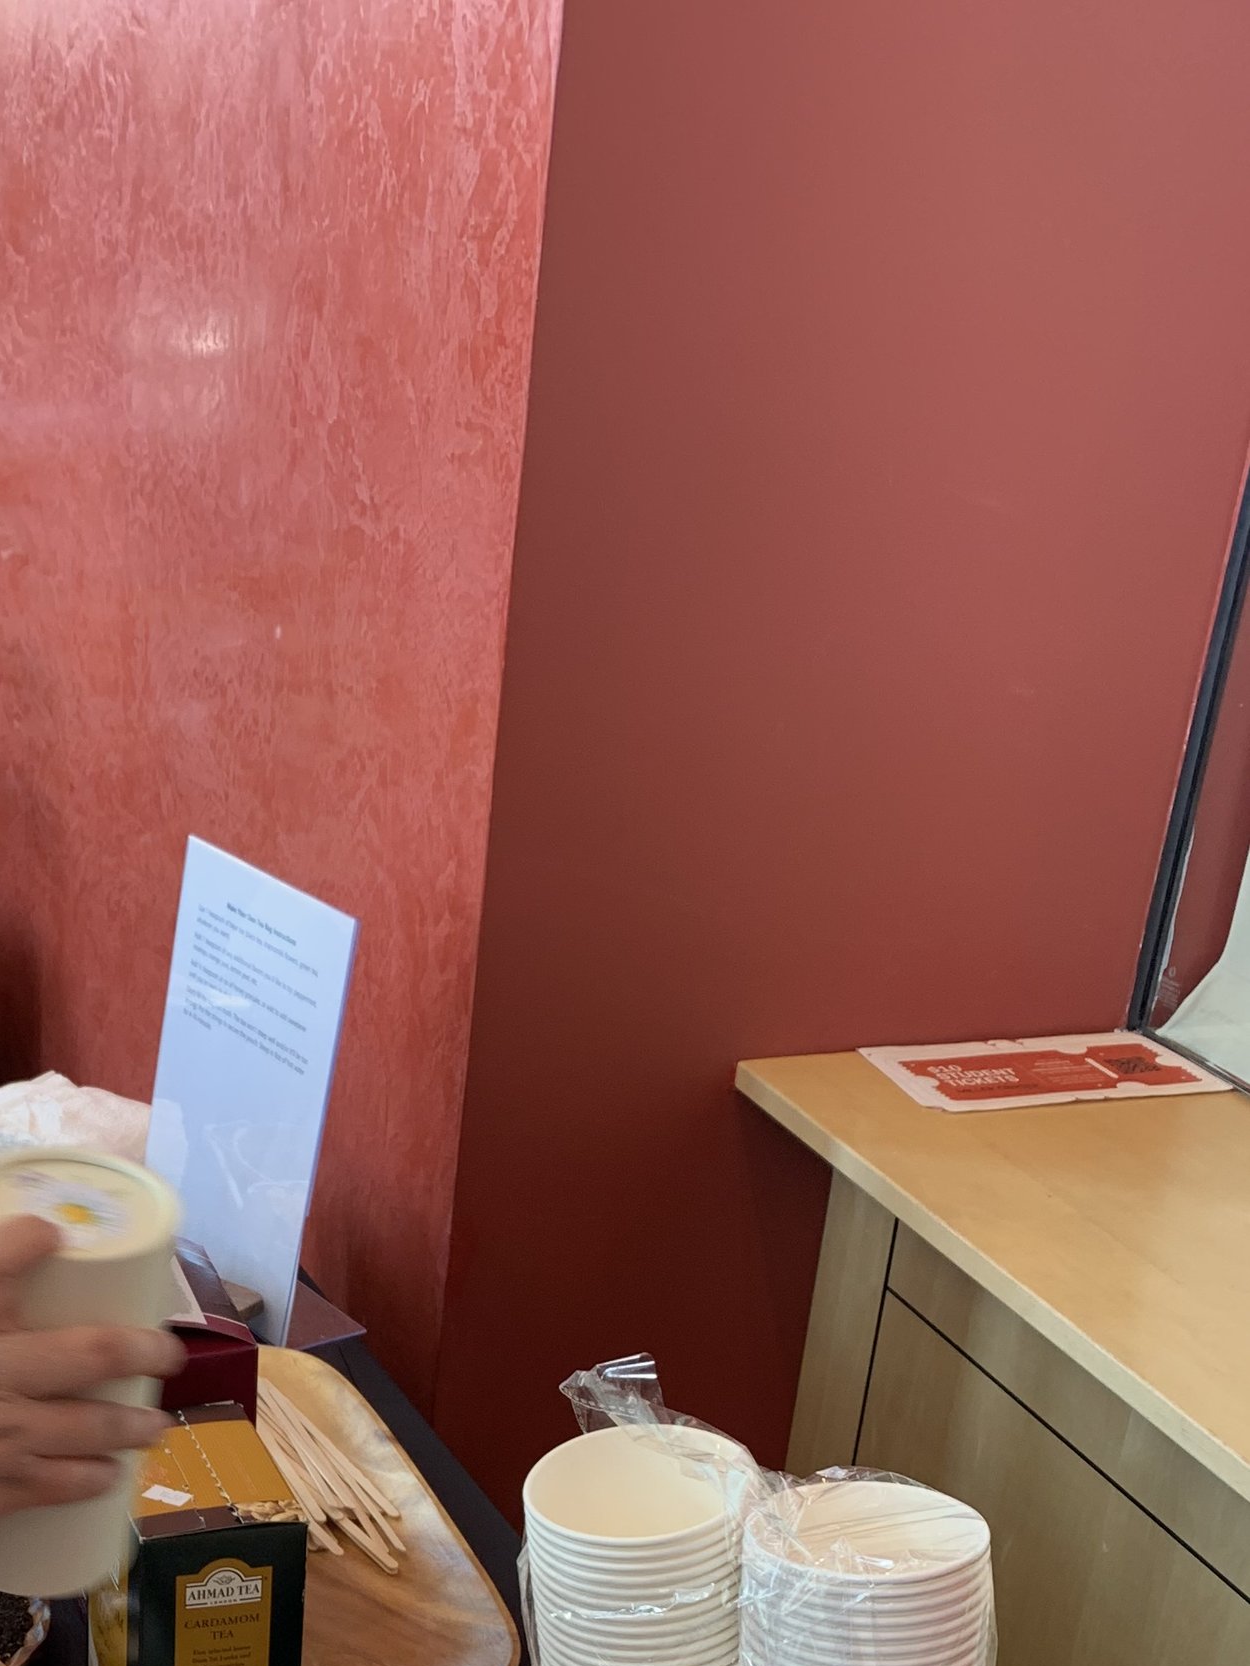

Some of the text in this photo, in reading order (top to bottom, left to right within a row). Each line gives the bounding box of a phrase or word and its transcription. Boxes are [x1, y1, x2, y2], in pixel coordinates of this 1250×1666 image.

[936, 1067, 1016, 1081] STUDENT
[944, 1075, 1020, 1087] TICKETS
[188, 1583, 260, 1601] AHMAD TEA
[184, 1613, 260, 1629] CARDAMOM
[211, 1630, 234, 1640] TEA
